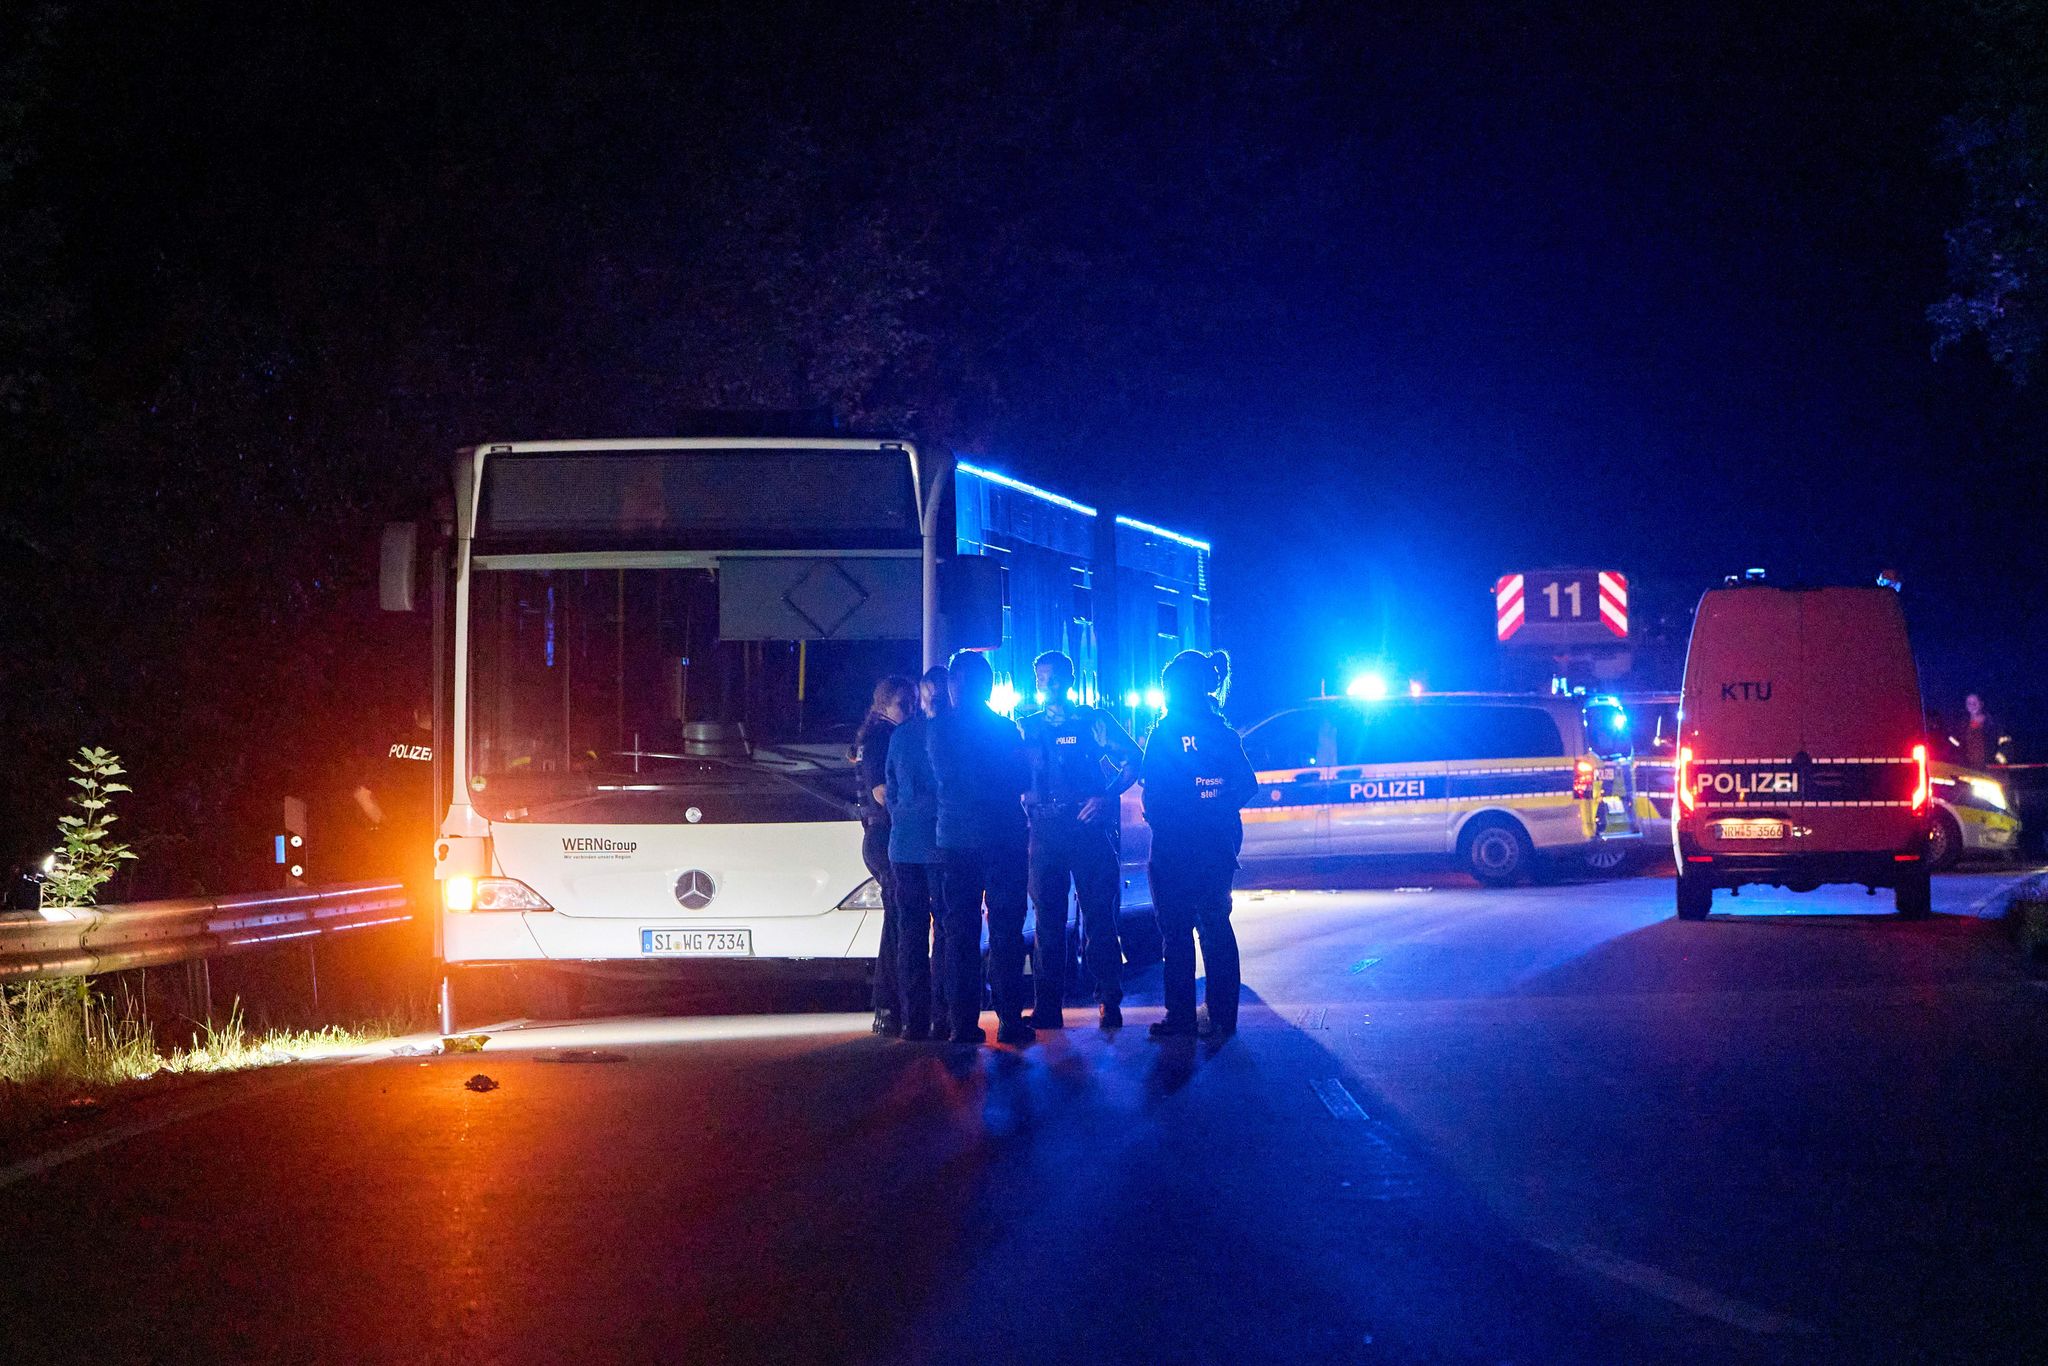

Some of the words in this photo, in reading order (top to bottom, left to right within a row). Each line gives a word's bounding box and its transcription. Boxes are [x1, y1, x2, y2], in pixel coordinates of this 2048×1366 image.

[1542, 582, 1581, 618] 11
[1721, 682, 1772, 700] KTU
[1350, 780, 1425, 799] POLIZEI
[1697, 773, 1798, 793] POLIZEI
[562, 837, 637, 853] WERNGroup
[655, 934, 672, 951] SI
[683, 934, 702, 951] WG
[707, 934, 744, 951] 7334
